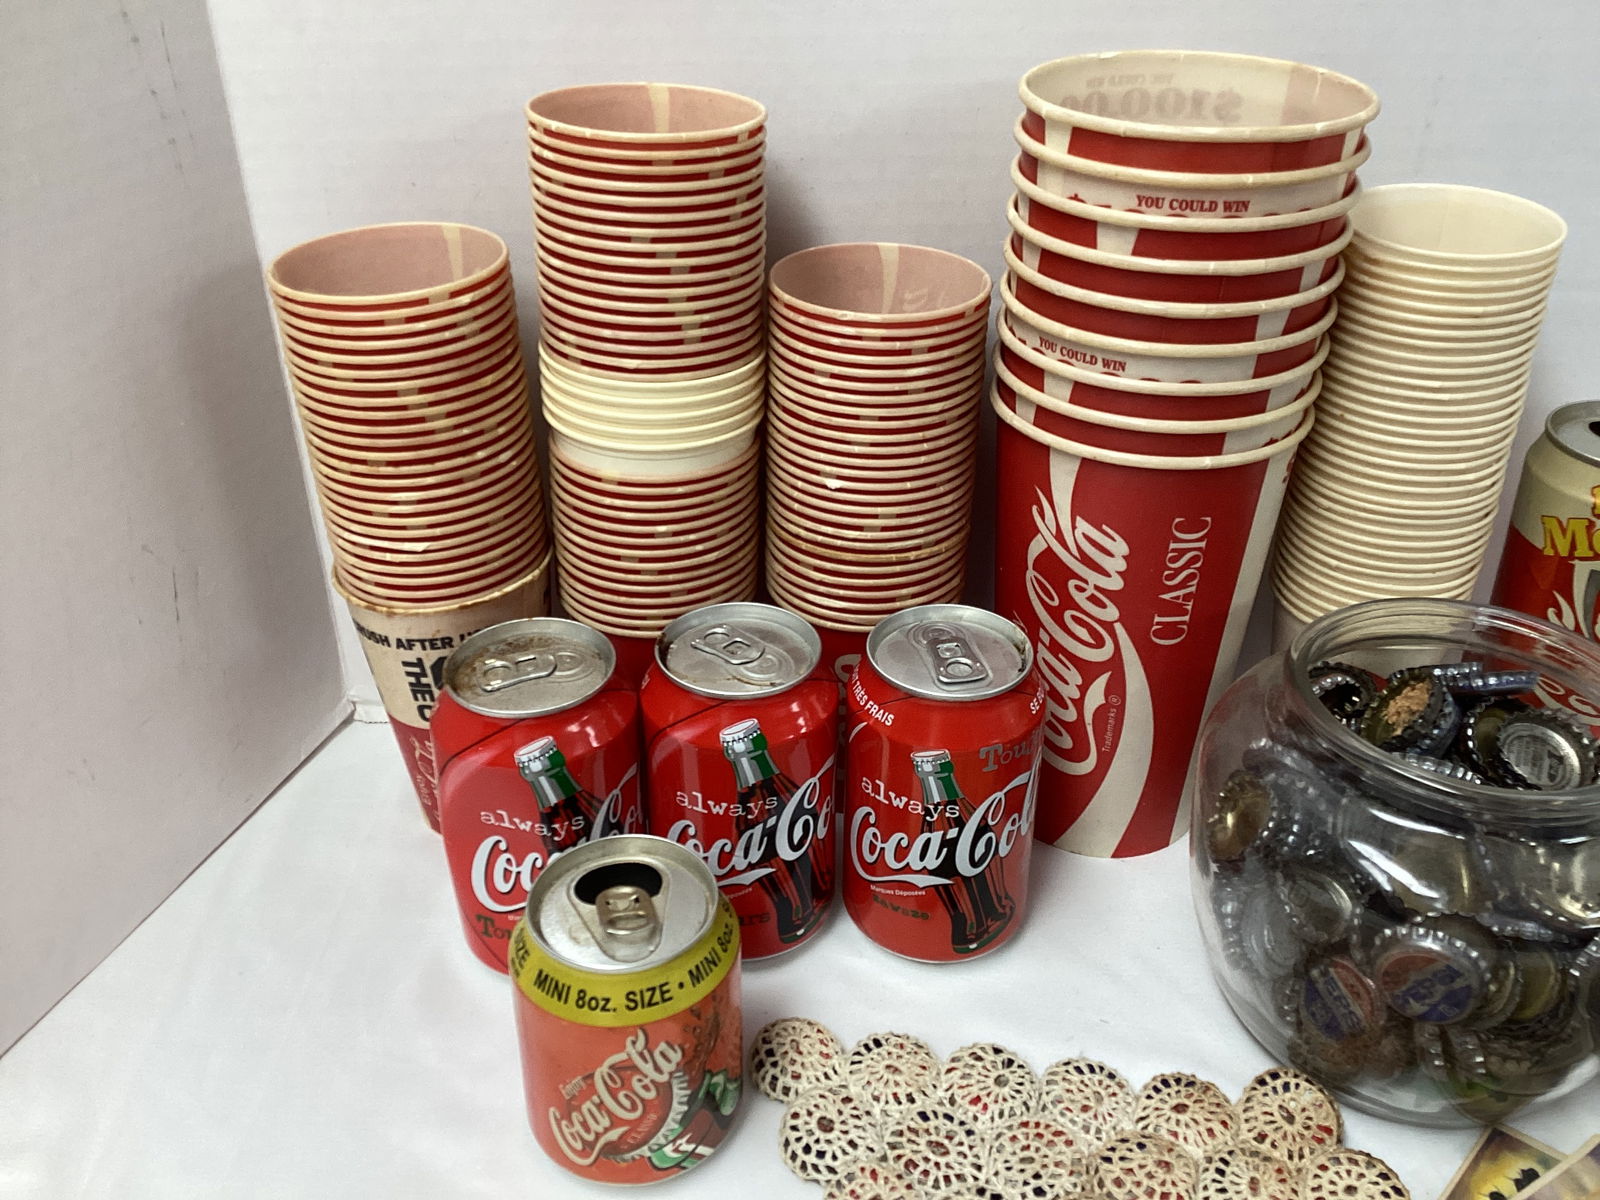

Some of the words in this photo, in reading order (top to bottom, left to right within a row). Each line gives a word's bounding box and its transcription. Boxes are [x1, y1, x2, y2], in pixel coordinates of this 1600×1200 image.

[1136, 194, 1165, 209] YOU
[1169, 198, 1218, 213] COULD
[1222, 200, 1251, 213] WIN
[1039, 335, 1058, 353] YOU
[1060, 346, 1098, 366] COULD
[1101, 358, 1127, 372] WIN
[1150, 516, 1212, 646] CLASSIC
[395, 636, 455, 651] AFTER
[401, 657, 436, 702] THE
[864, 700, 895, 727] FRAIS
[676, 791, 778, 819] always
[850, 745, 1042, 889] Coca-Col
[862, 777, 960, 821] always
[480, 809, 586, 841] always
[533, 968, 570, 1006] MINI
[576, 989, 617, 1013] 8oz.
[624, 981, 673, 1011] SIZE
[688, 946, 722, 988] MINI
[548, 1027, 683, 1166] Coca-Cola
